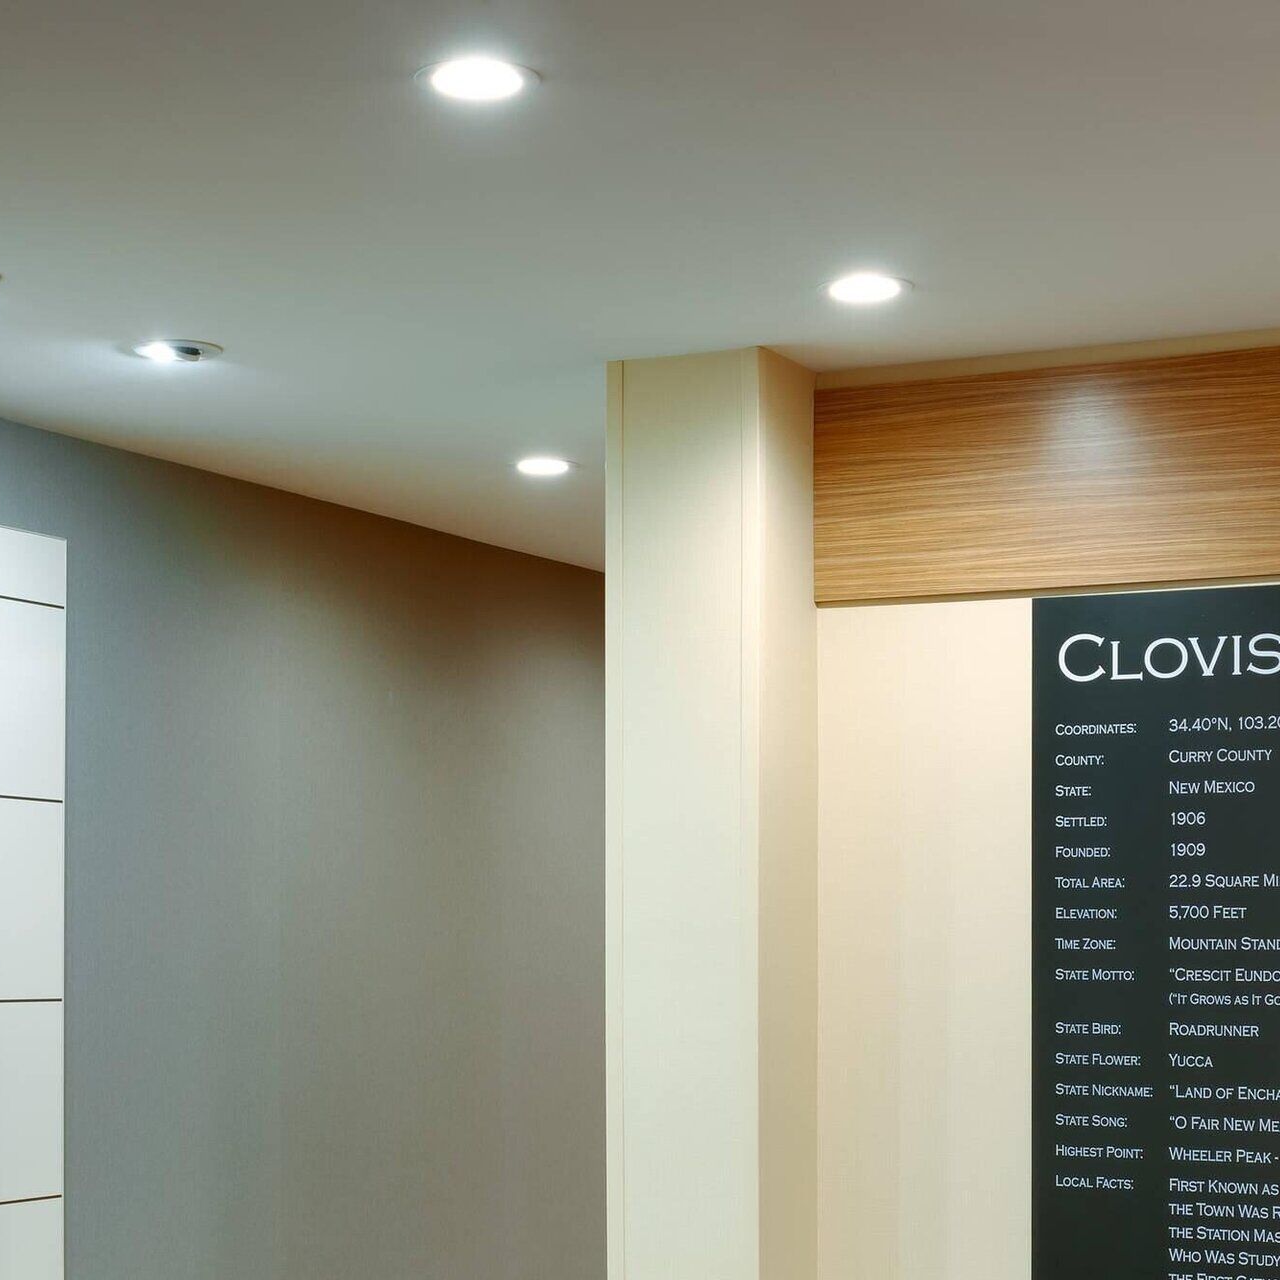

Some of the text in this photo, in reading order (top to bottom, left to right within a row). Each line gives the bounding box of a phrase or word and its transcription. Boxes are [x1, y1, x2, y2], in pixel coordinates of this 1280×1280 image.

[1054, 722, 1137, 736] COORDINATES:
[1054, 753, 1105, 768] COUNTY:
[1168, 747, 1273, 764] CURRY COUNTY
[1055, 784, 1092, 798] STATE:
[1169, 779, 1256, 795] NEW MEXICO
[1055, 814, 1108, 829] SETTLED:
[1170, 810, 1206, 826] 1906
[1055, 845, 1111, 859] FOUNDED:
[1170, 841, 1206, 857] 1909
[1054, 875, 1125, 889] TOTAL AREA:
[1169, 873, 1202, 889] 22.9
[1204, 873, 1260, 890] SQUARE
[1055, 906, 1118, 920] ELEVATION:
[1169, 904, 1248, 921] 5,700 FEET
[1054, 936, 1117, 950] TIME ZONE:
[1169, 935, 1237, 951] MOUNTAIN
[1055, 967, 1135, 982] STATE MOTTO:
[1189, 992, 1232, 1006] GROWS
[1233, 994, 1249, 1006] AS
[1251, 992, 1263, 1006] IT
[1055, 1020, 1122, 1036] STATE BIRD:
[1169, 1021, 1260, 1038] ROADRUNNER
[1055, 1051, 1141, 1067] STATE FLOWER:
[1168, 1052, 1214, 1069] YUCCA
[1055, 1082, 1154, 1099] STATE NICKNAME:
[1215, 1087, 1235, 1101] OF
[1055, 1112, 1128, 1129] STATE SONG:
[1191, 1115, 1220, 1131] FAIR
[1223, 1116, 1256, 1132] NEW
[1055, 1143, 1144, 1160] HIGHEST POINT:
[1168, 1145, 1233, 1163] WHEELER
[1235, 1147, 1272, 1165] PEAK
[1055, 1174, 1134, 1191] LOCAL FACTS:
[1169, 1176, 1206, 1194] FIRST
[1208, 1178, 1259, 1196] KNOWN
[1261, 1182, 1280, 1196] AS
